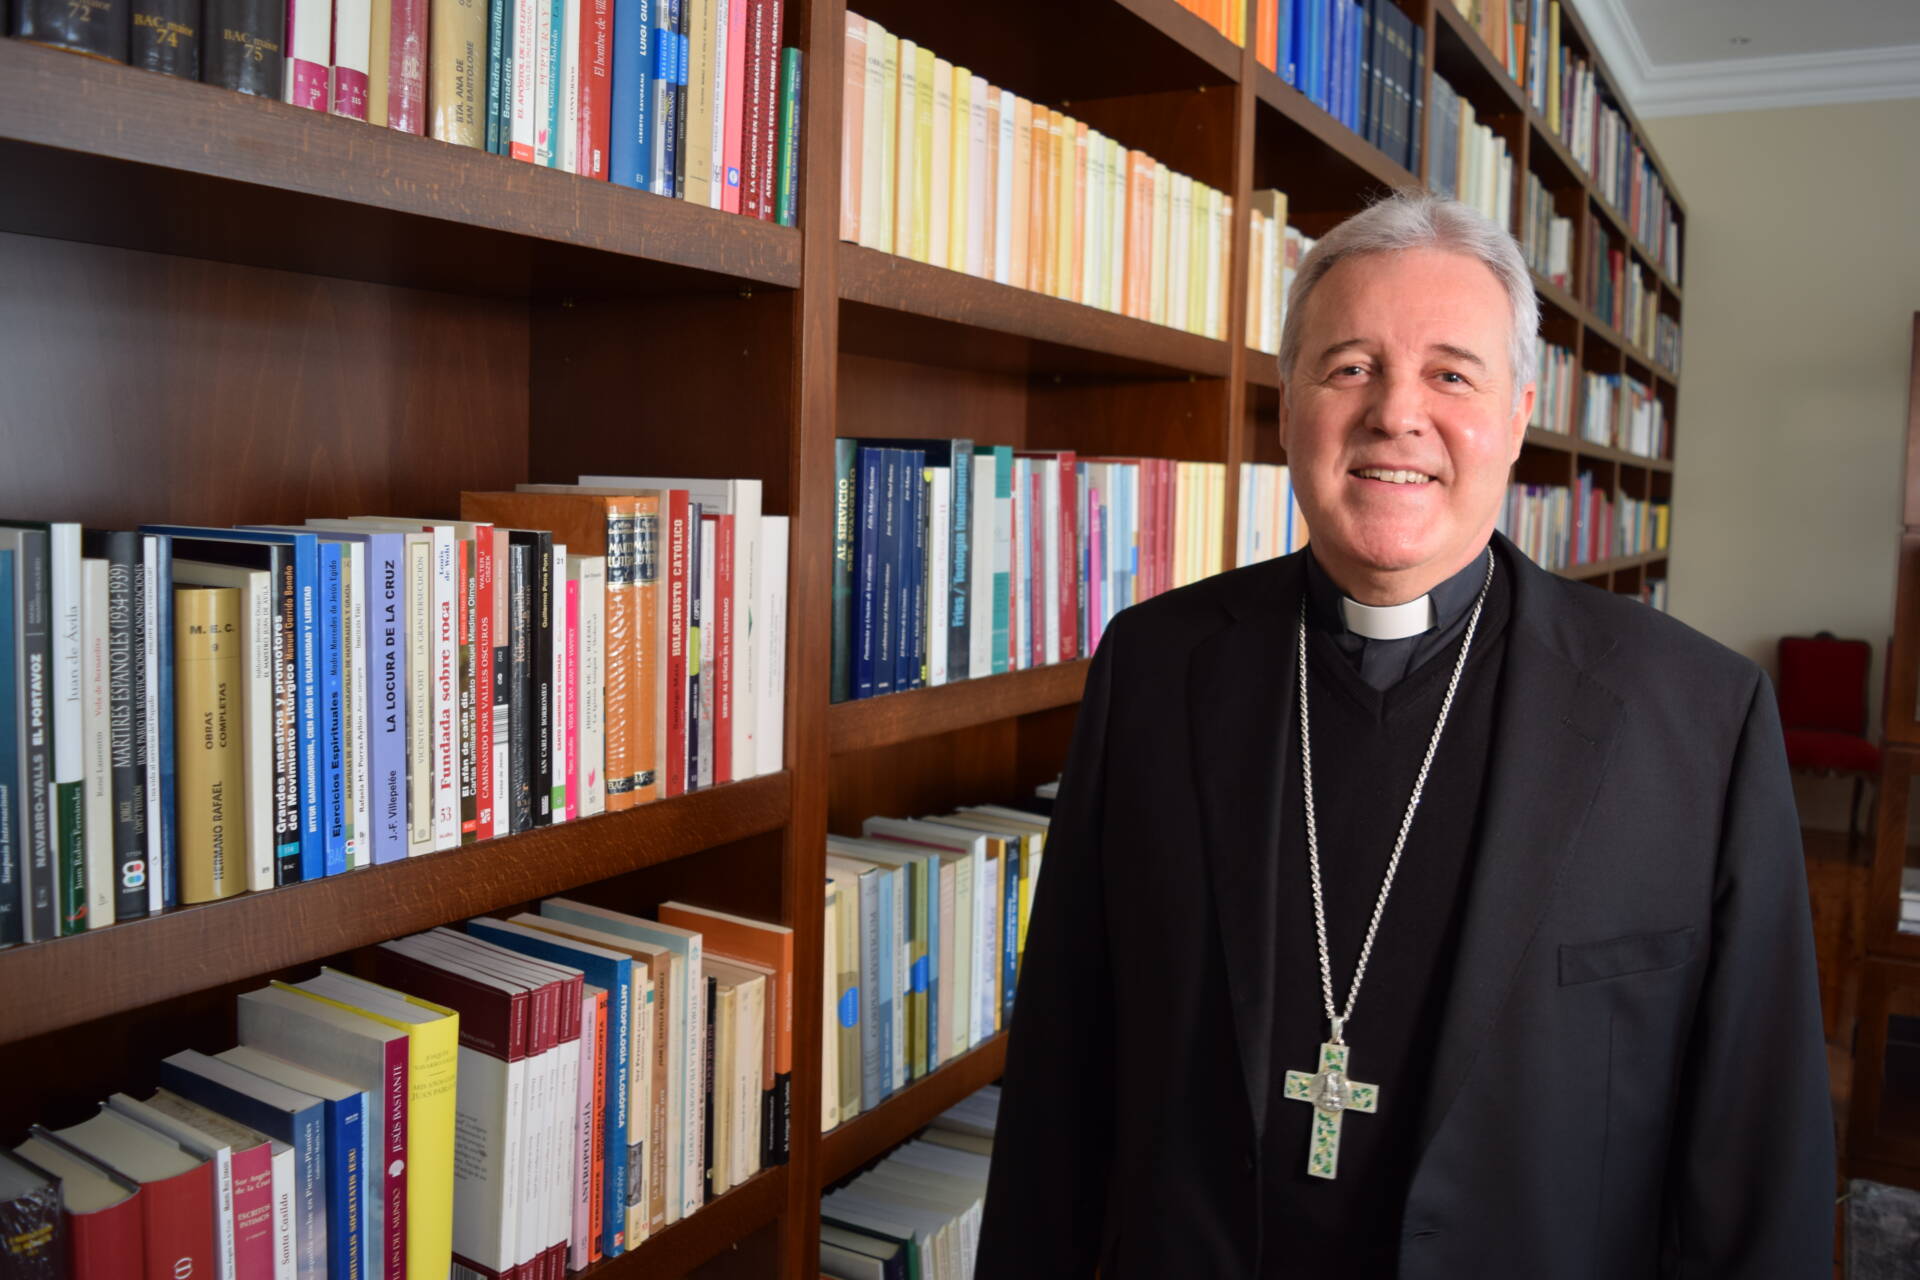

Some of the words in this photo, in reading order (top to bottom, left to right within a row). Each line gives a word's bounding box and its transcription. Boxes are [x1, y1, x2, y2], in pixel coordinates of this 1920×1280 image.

[134, 13, 165, 29] BAC
[223, 28, 251, 45] BAC
[492, 0, 504, 59] Maravillas
[595, 17, 606, 29] de
[754, 3, 764, 56] ESCRITURA
[771, 0, 780, 44] ORACION
[155, 28, 180, 49] 74
[243, 43, 265, 63] 75
[593, 31, 606, 65] hombre
[640, 25, 648, 57] LUIGI
[770, 45, 778, 58] LA
[456, 58, 465, 74] DE
[491, 61, 501, 99] Madre
[593, 66, 605, 78] El
[753, 57, 761, 104] SAGRADA
[769, 59, 777, 91] SOBRE
[456, 75, 465, 98] ANA
[502, 57, 513, 119] Bernadette
[465, 106, 474, 126] SAN
[490, 102, 499, 116] La
[517, 106, 524, 119] EL
[752, 106, 759, 119] LA
[767, 92, 776, 127] TEXTOS
[637, 113, 645, 145] ALBERTO
[751, 120, 758, 132] EN
[766, 128, 774, 142] DE
[750, 134, 758, 179] ORACION
[765, 144, 774, 198] ANTOLOGIA
[750, 180, 757, 193] LA
[847, 468, 856, 543] EVANGELIO
[954, 453, 969, 531] fundamental
[837, 478, 849, 541] SERVICIO
[541, 552, 549, 572] Pons
[672, 519, 684, 577] CATÓLICO
[836, 543, 847, 561] AL
[952, 532, 969, 584] Teología
[109, 563, 130, 629] (1934-1939)
[282, 565, 293, 595] Bonaño
[328, 583, 338, 603] Jesús
[384, 560, 395, 600] CRUZ
[415, 556, 424, 616] PERSECUCIÓN
[467, 578, 476, 607] Olmos
[541, 573, 549, 592] Pons
[133, 563, 145, 634] CANONIZACIONES
[283, 599, 293, 628] Garrido
[303, 586, 313, 623] LIBERTAD
[329, 604, 338, 614] de
[384, 604, 395, 622] LA
[541, 592, 549, 628] Guillermo
[951, 596, 965, 627] Fries
[62, 605, 78, 642] Ávila
[329, 616, 338, 650] Mercedes
[416, 618, 424, 642] GRAN
[440, 599, 451, 641] roca
[467, 608, 476, 642] Medina
[671, 581, 683, 657] HOLOCAUSTO
[284, 631, 294, 660] Manuel
[385, 627, 395, 646] DE
[416, 645, 424, 656] LA
[480, 616, 489, 667] OSCUROS
[722, 644, 729, 655] EN
[65, 647, 79, 665] de
[273, 615, 286, 694] promotores
[304, 632, 314, 684] SOLIDARIDAD
[329, 652, 338, 676] Madre
[468, 644, 476, 677] Manuel
[30, 653, 43, 727] PORTAVOZ
[66, 669, 81, 702] Juan
[94, 684, 103, 696] de
[135, 642, 147, 710] BEATIFICACIONES
[305, 685, 314, 696] DE
[385, 649, 396, 710] LOCURA
[438, 649, 451, 702] sobre
[480, 669, 489, 710] VALLES
[722, 682, 729, 692] AL
[94, 697, 104, 717] Vida
[275, 697, 286, 706] y
[284, 664, 297, 724] Litúrgico
[304, 697, 315, 719] AÑOS
[460, 691, 469, 709] día
[540, 682, 548, 726] BORROMEO
[136, 719, 148, 743] PABLO
[204, 711, 214, 751] OBRAS
[218, 682, 229, 749] COMPLETAS
[306, 720, 316, 739] CIEN
[329, 691, 341, 769] Espirituales
[387, 714, 397, 733] LA
[461, 711, 469, 738] cada
[481, 711, 489, 733] POR
[32, 729, 43, 746] EL
[149, 736, 157, 763] servicio
[274, 710, 286, 773] maestros
[417, 727, 425, 764] VICENTE
[438, 708, 451, 790] Fundada
[461, 742, 469, 755] de
[540, 728, 548, 758] CARLOS
[136, 744, 148, 766] JUAN
[285, 729, 298, 806] Movimiento
[461, 758, 470, 783] afán
[481, 734, 489, 798] CAMINANDO
[540, 759, 548, 775] SAN
[388, 770, 400, 819] Villepelée
[461, 785, 470, 797] El
[469, 766, 477, 796] Cartas
[0, 784, 10, 843] Internacional
[33, 754, 47, 868] NAVARRO-VALLS
[211, 781, 224, 822] RAFAEL
[275, 777, 287, 833] Grandes
[331, 773, 342, 838] Ejercicios
[286, 810, 298, 831] del
[388, 820, 399, 841] J.-F.
[1, 845, 13, 884] Simposio
[212, 825, 225, 881] HERMANO
[618, 984, 629, 1065] ANTROPOLOGÍA
[392, 1063, 404, 1120] BASTANTE
[617, 1068, 627, 1129] FILOSÓFICA
[390, 1121, 404, 1153] JESÚS
[581, 1101, 592, 1204] ANTROPOLOGÍA
[278, 1193, 290, 1232] Casilda
[306, 1198, 314, 1211] en
[347, 1174, 358, 1233] SOCIETATIS
[304, 1212, 315, 1239] noche
[279, 1234, 291, 1266] Santa
